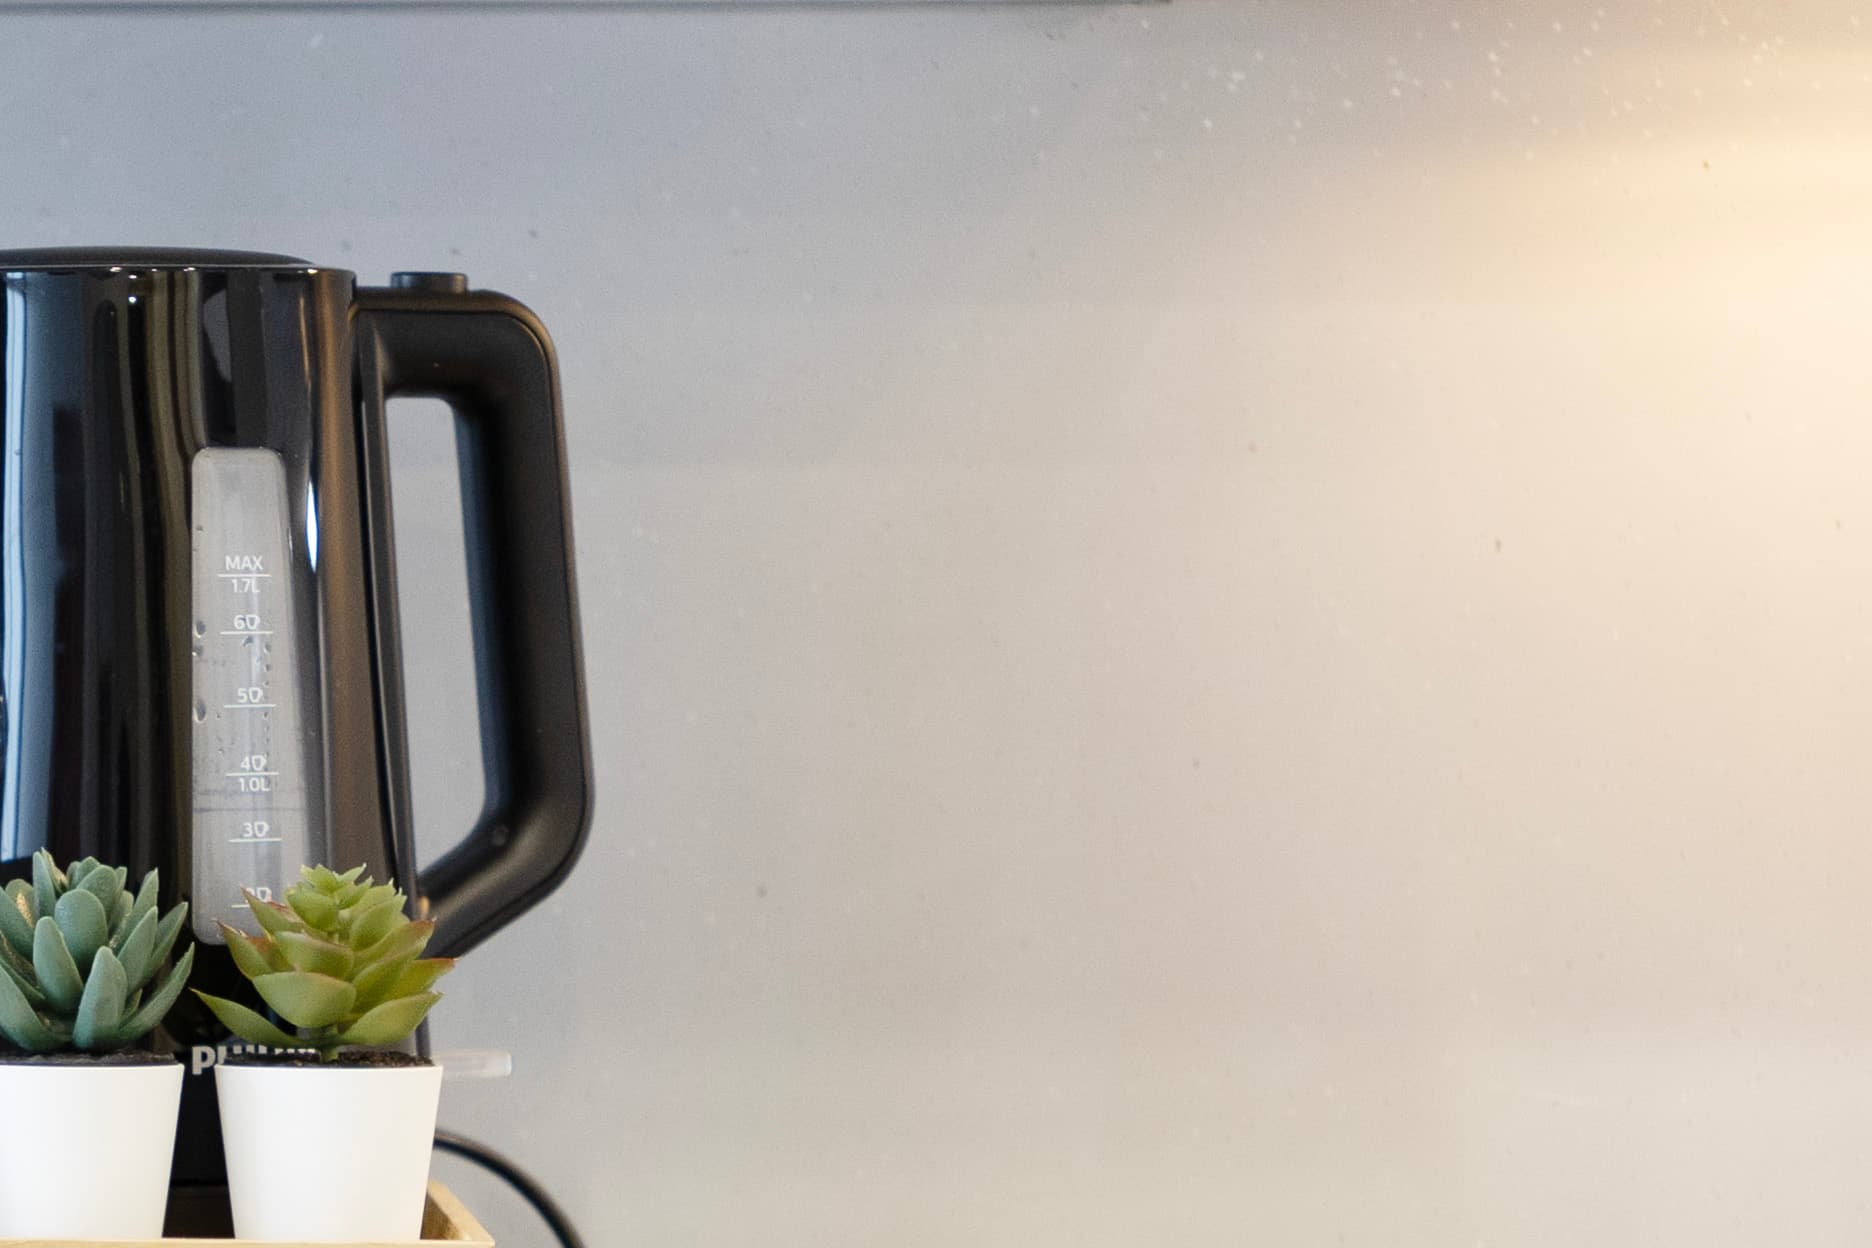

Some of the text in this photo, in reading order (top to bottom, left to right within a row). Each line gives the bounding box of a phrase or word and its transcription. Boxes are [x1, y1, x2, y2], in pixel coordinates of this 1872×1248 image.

[225, 555, 263, 571] MAX
[231, 579, 260, 593] 1.7L
[239, 778, 271, 792] 1.0L
